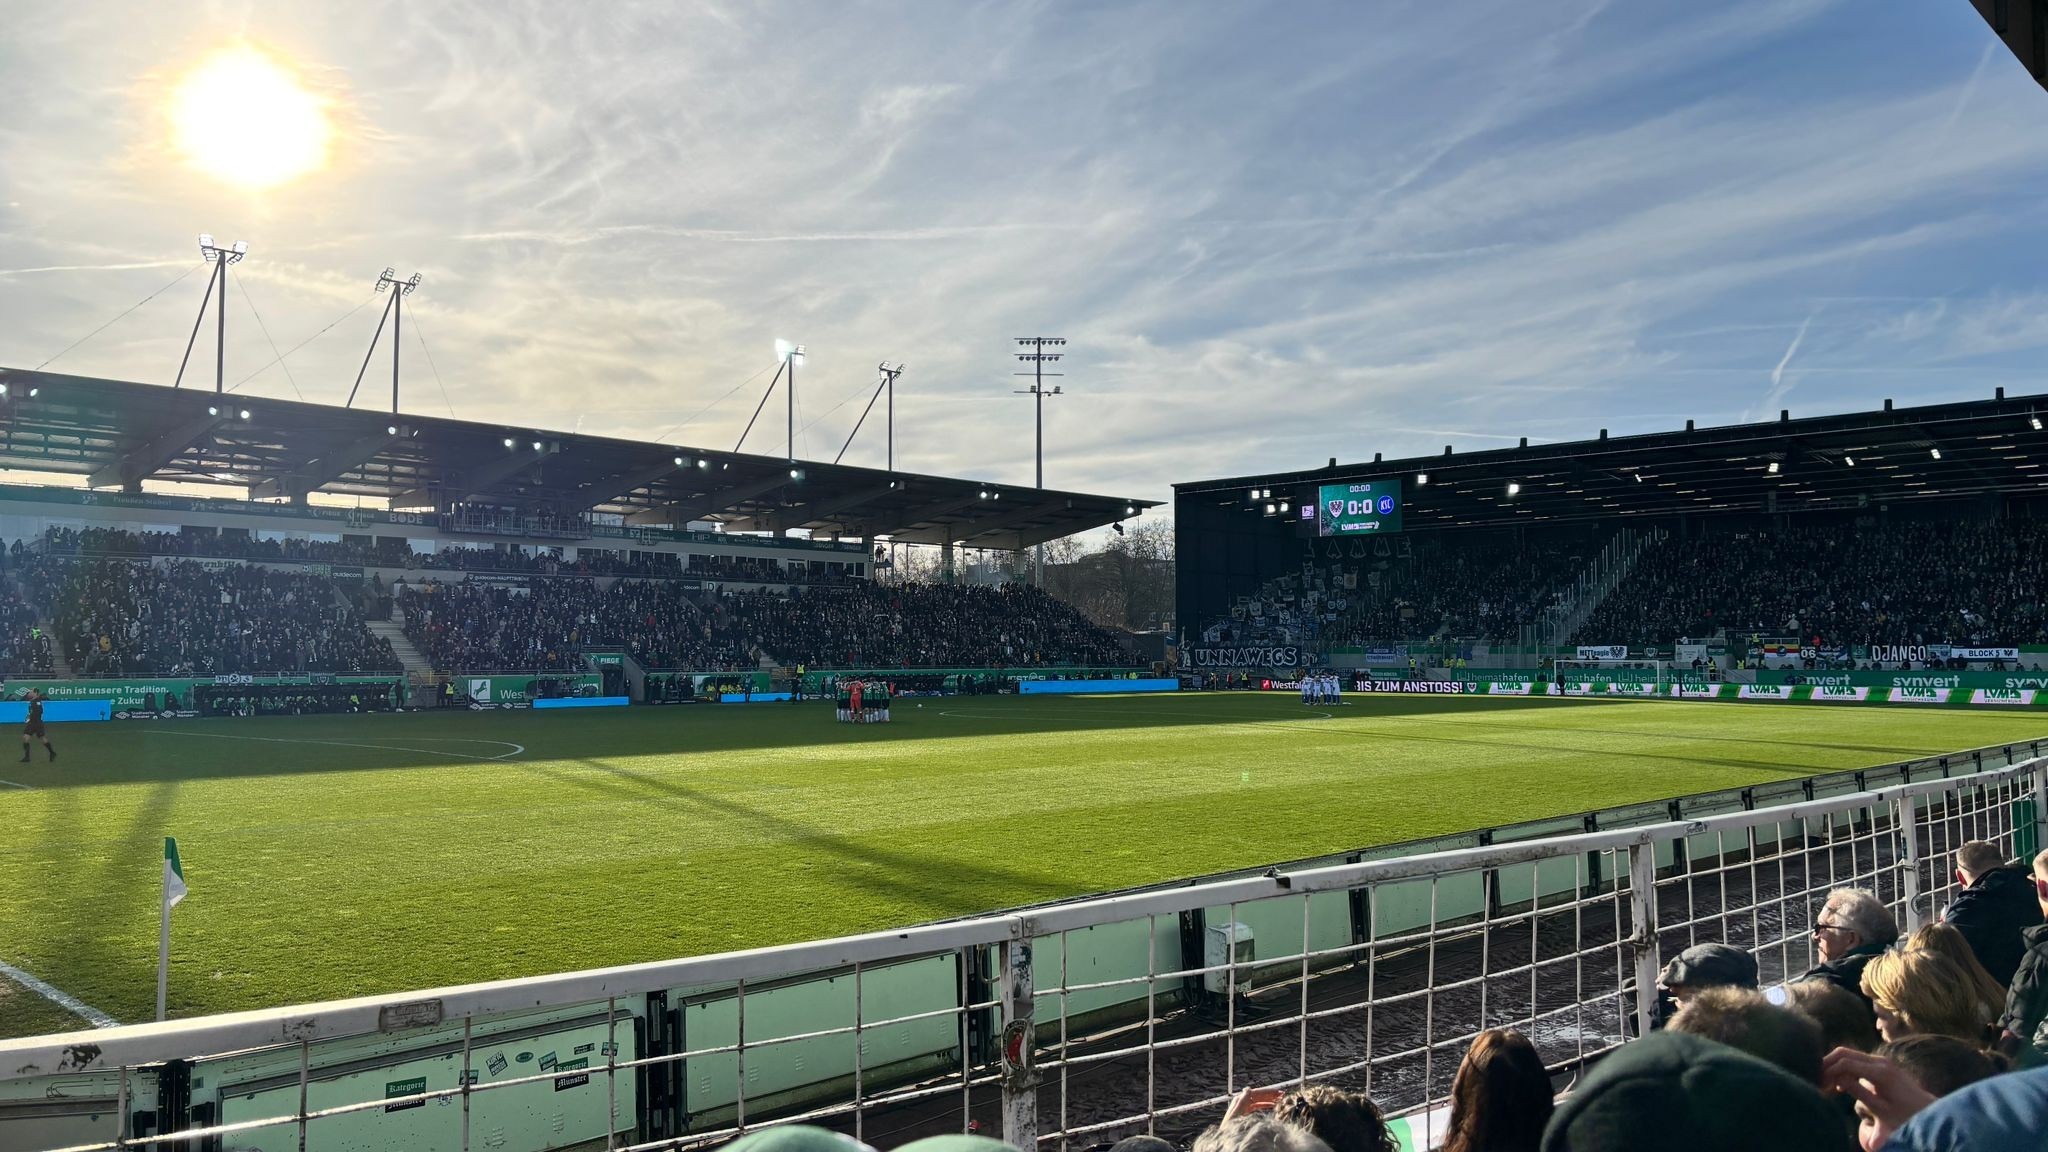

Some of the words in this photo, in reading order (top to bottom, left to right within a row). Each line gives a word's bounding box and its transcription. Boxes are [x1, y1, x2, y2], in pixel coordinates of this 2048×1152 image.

[1349, 484, 1371, 493] 00:00
[1347, 499, 1373, 515] 0:0
[1380, 499, 1391, 511] KSC
[707, 582, 715, 592] D
[1195, 646, 1297, 666] UNNAWEGS
[1800, 649, 1817, 658] 06
[1872, 645, 1926, 662] DJANGO
[1968, 649, 1994, 657] BLOCK
[1995, 649, 2000, 657] 5
[1471, 673, 1529, 682] heimathafen
[1550, 672, 1612, 683] hmathafen
[1634, 675, 1701, 684] heimathfen
[1807, 674, 1851, 686] nvert
[2005, 677, 2048, 689] synv
[48, 687, 72, 695] Grün
[74, 687, 87, 695] ist
[88, 686, 123, 694] unsere
[124, 685, 169, 694] Tradition.
[1374, 681, 1400, 692] ZUM
[1402, 681, 1463, 693] ANSTOSS!
[557, 1075, 587, 1088] Münster
[389, 1082, 425, 1093] Kategorie
